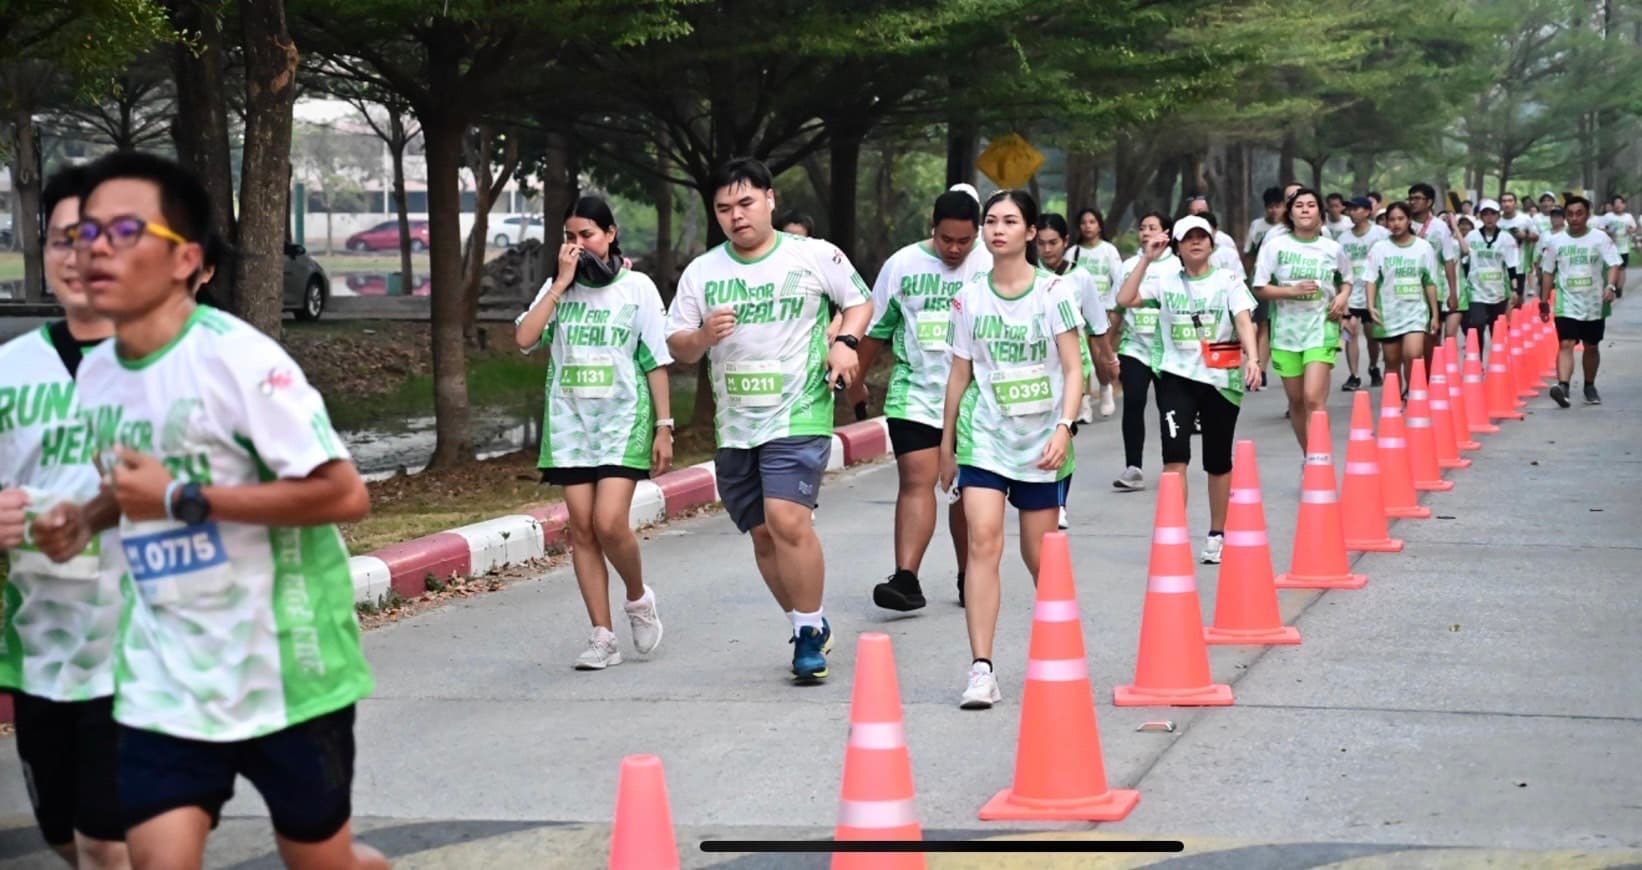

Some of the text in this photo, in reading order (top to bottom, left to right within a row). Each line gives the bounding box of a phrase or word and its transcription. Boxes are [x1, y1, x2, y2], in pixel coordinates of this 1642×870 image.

[1278, 250, 1301, 265] RUN
[704, 277, 775, 306] RUN FOR
[901, 273, 941, 296] RUN
[585, 309, 611, 324] FOR
[733, 296, 805, 325] HEALTH
[1004, 324, 1028, 341] FOR
[1183, 327, 1211, 337] 015
[989, 340, 1047, 363] HEALTH
[576, 369, 605, 383] 1131
[741, 377, 775, 391] 0211
[1009, 381, 1049, 399] 0393
[0, 382, 76, 433] RUN
[145, 532, 216, 571] 0775
